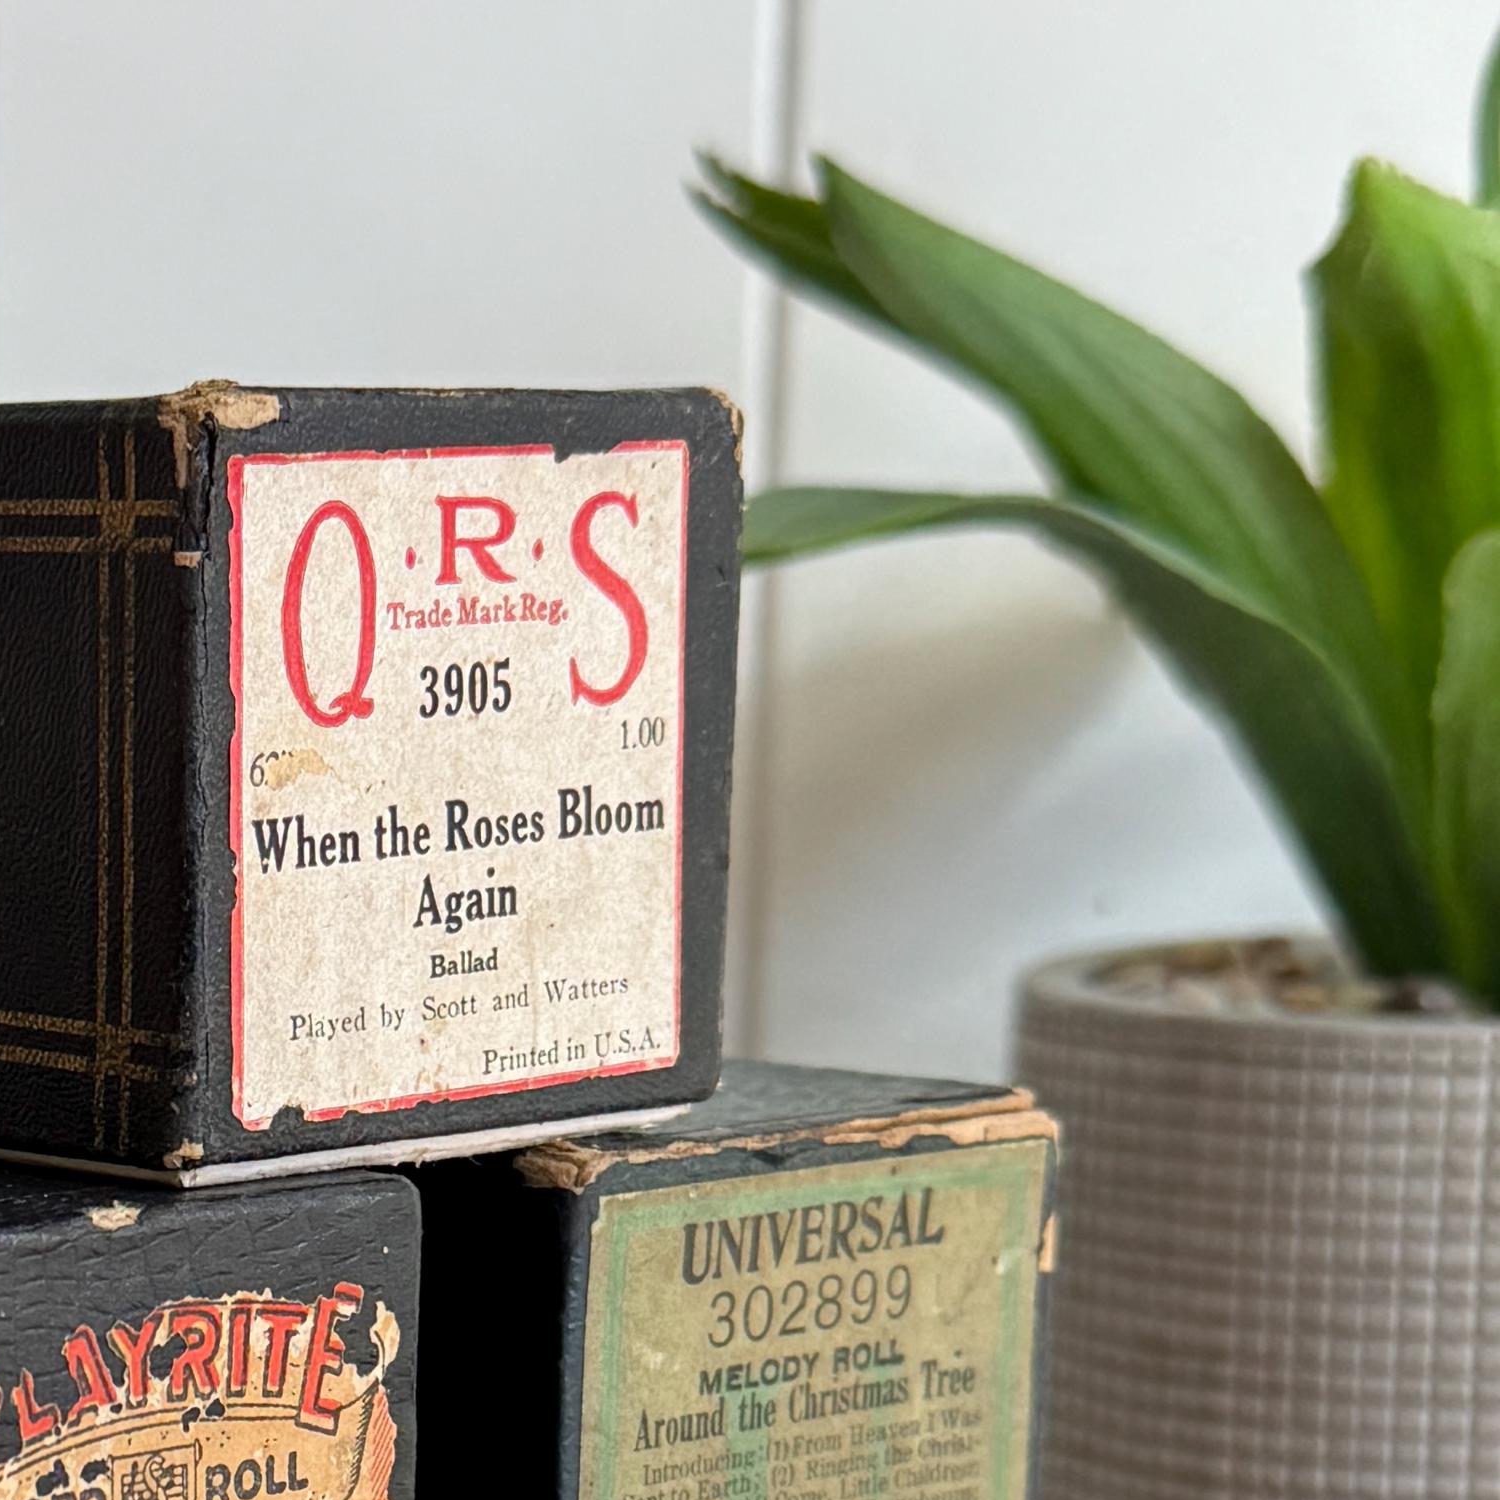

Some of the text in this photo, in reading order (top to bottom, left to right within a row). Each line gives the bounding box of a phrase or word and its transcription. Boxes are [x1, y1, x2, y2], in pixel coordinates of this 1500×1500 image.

[386, 593, 570, 631] Trade Mark Reg.
[419, 657, 513, 719] 3905
[619, 716, 665, 750] 1.00
[252, 785, 665, 874] When the Roses Bloom
[413, 867, 518, 933] Again
[430, 947, 499, 979] Ballad
[289, 976, 630, 1041] Played by Scott and Watters
[482, 1026, 662, 1075] Printed in U.S.A.
[682, 1186, 945, 1285] UNIVERSAL
[707, 1264, 913, 1349] 302899
[700, 1338, 906, 1395] MELODY ROLL
[633, 1358, 976, 1452] Around the Christmas Tree
[770, 1465, 795, 1486] (2)
[806, 1449, 878, 1481] Ringing
[840, 1472, 889, 1498] Little
